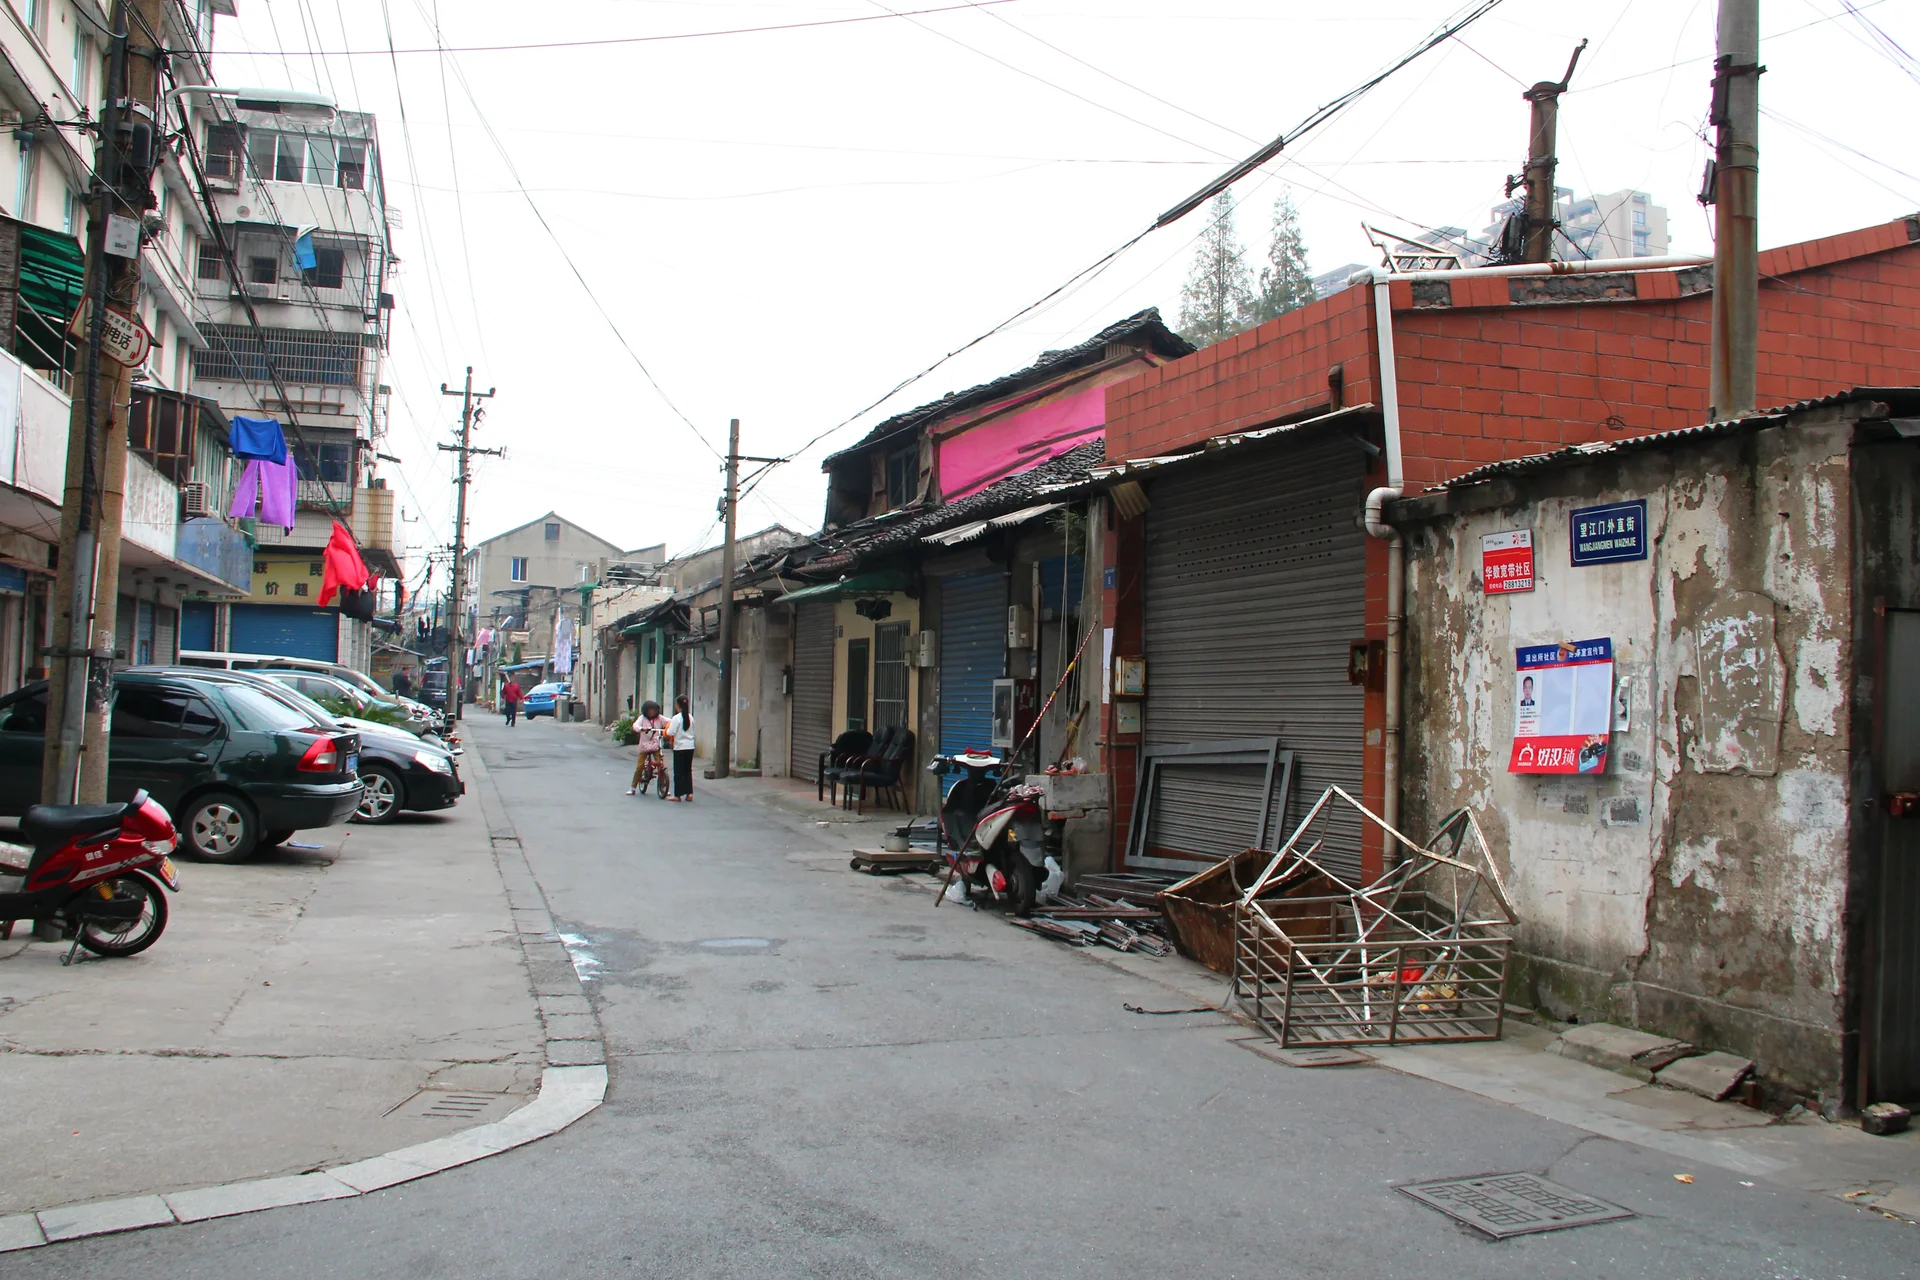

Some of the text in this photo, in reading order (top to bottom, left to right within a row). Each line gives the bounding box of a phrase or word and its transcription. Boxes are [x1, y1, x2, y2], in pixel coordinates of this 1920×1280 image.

[1580, 516, 1635, 538] 望江门外直街
[1579, 537, 1636, 552] WANGJIANGMEN WAIZHIJIE
[1485, 562, 1530, 580] 华数宽带社区
[1536, 748, 1576, 766] 好汉锁
